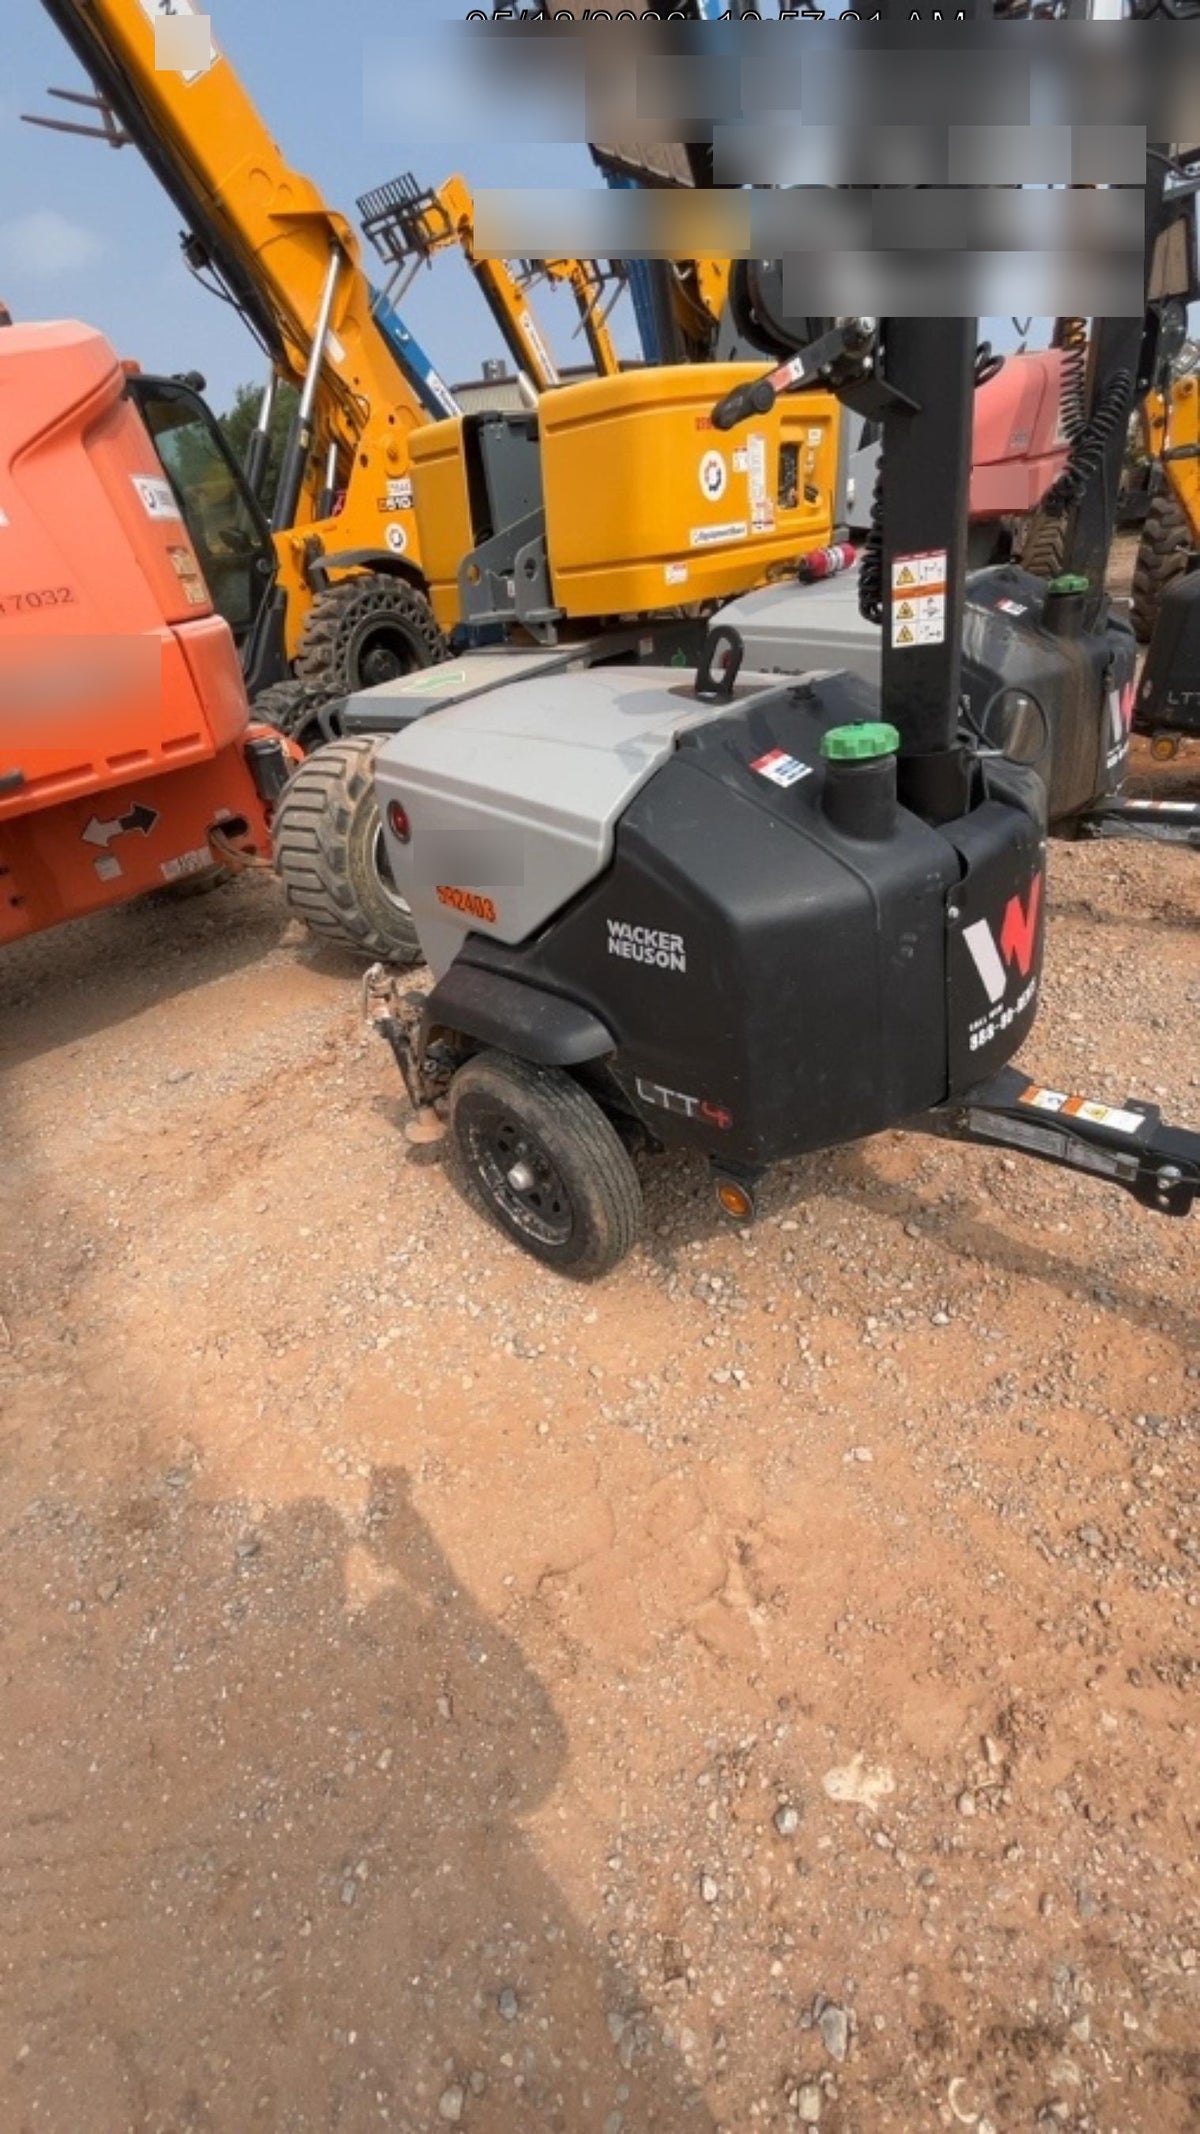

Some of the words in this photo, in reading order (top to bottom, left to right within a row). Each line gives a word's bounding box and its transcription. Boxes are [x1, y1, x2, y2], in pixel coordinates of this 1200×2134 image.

[607, 919, 685, 954] WACKER
[608, 937, 687, 973] NEUSON
[635, 1077, 732, 1129] LTT4
